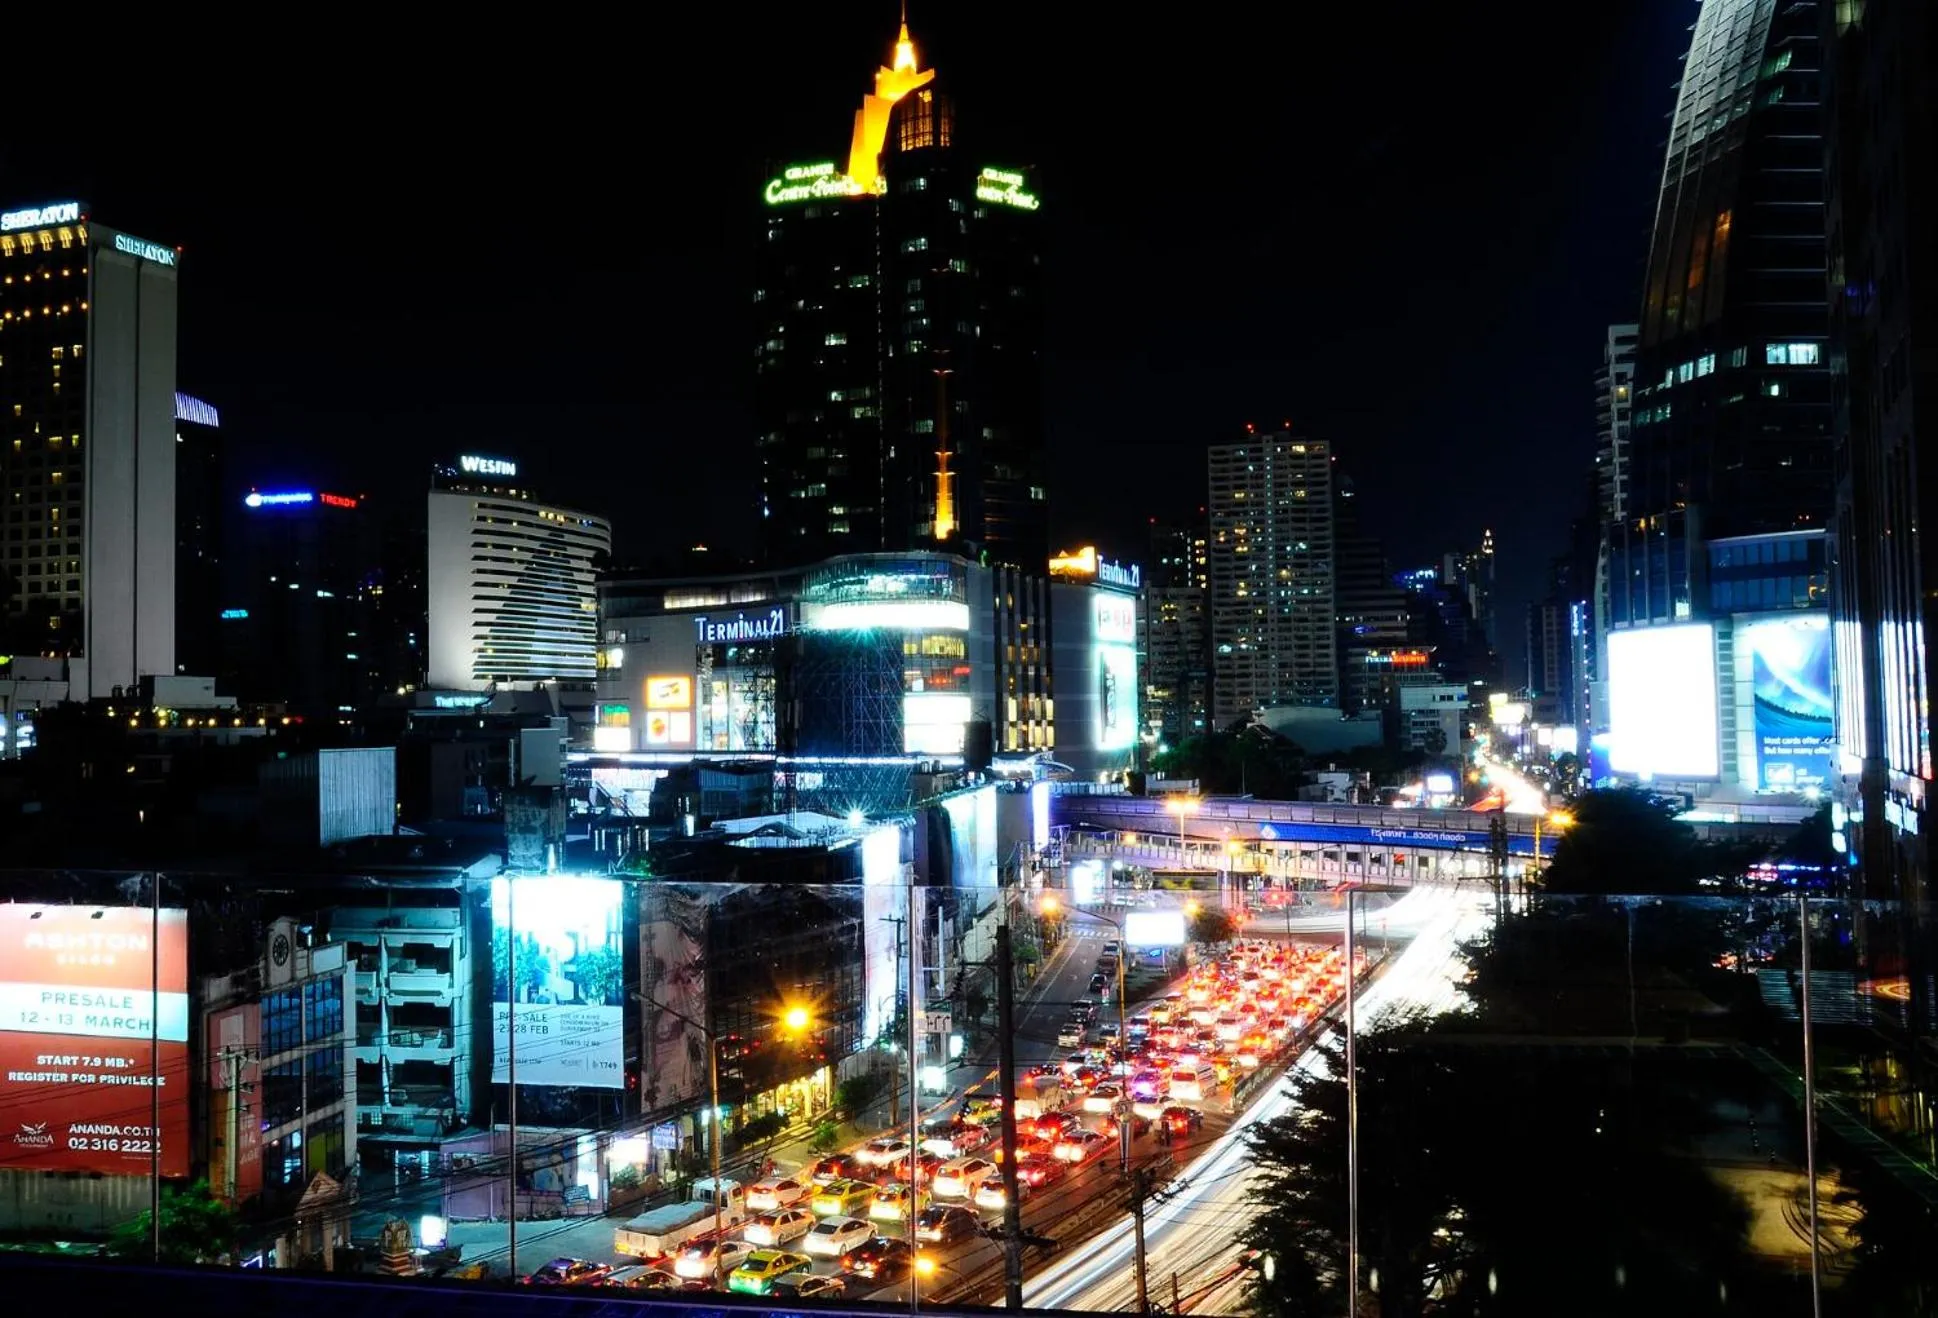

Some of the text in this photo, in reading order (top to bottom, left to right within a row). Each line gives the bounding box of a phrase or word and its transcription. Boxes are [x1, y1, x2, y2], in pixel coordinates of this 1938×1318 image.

[0, 202, 79, 231] SHERATON
[115, 234, 174, 266] SHERATON
[461, 455, 516, 476] WESTIN
[769, 608, 784, 636] 21
[25, 931, 147, 950] ASHTON
[41, 991, 134, 1009] PRESALE
[20, 1011, 39, 1024] 12
[58, 1013, 74, 1026] 13
[84, 1014, 150, 1031] MARCH
[530, 1025, 549, 1034] FEB
[37, 1055, 79, 1066] START
[82, 1056, 101, 1067] 7.9
[8, 1071, 68, 1083] REGISTER
[71, 1073, 96, 1084] FOR
[13, 1133, 54, 1145] ANANDA
[68, 1137, 88, 1150] 02
[91, 1138, 118, 1151] 316
